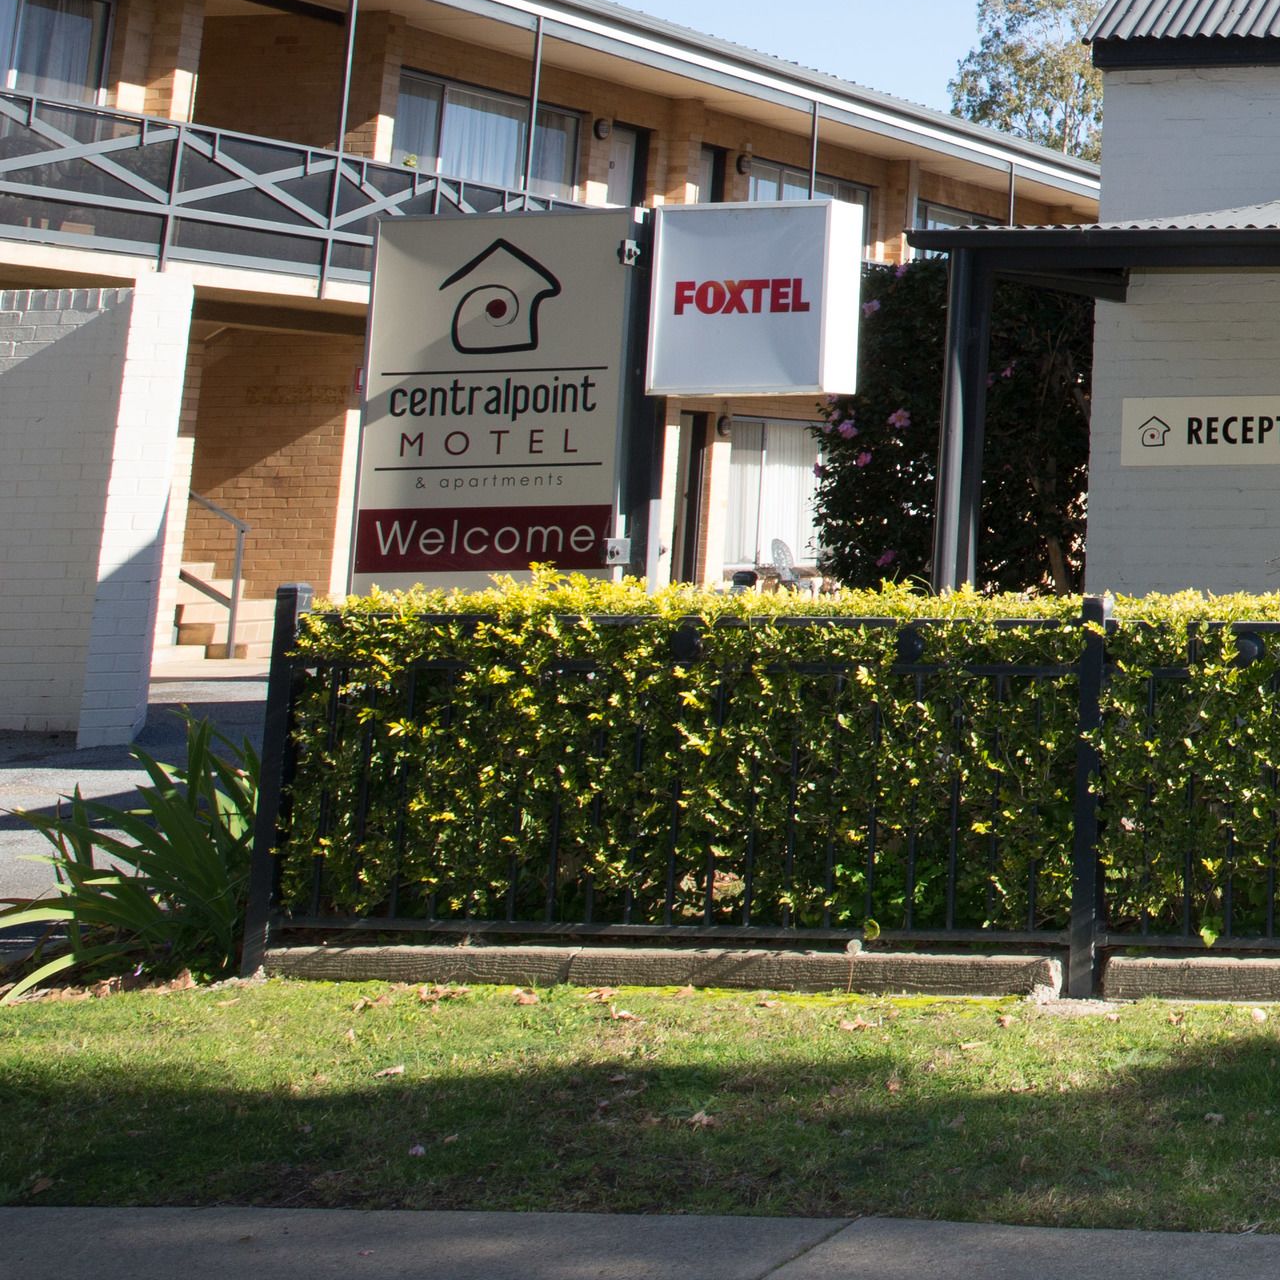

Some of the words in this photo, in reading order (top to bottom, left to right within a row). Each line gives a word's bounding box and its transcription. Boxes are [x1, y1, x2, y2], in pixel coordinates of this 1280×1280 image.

[673, 277, 810, 316] FOXTEL
[388, 375, 597, 422] centralpoint
[399, 427, 578, 457] MOTEL
[415, 475, 426, 489] &
[439, 472, 564, 491] apartments
[375, 519, 596, 556] Welcome
